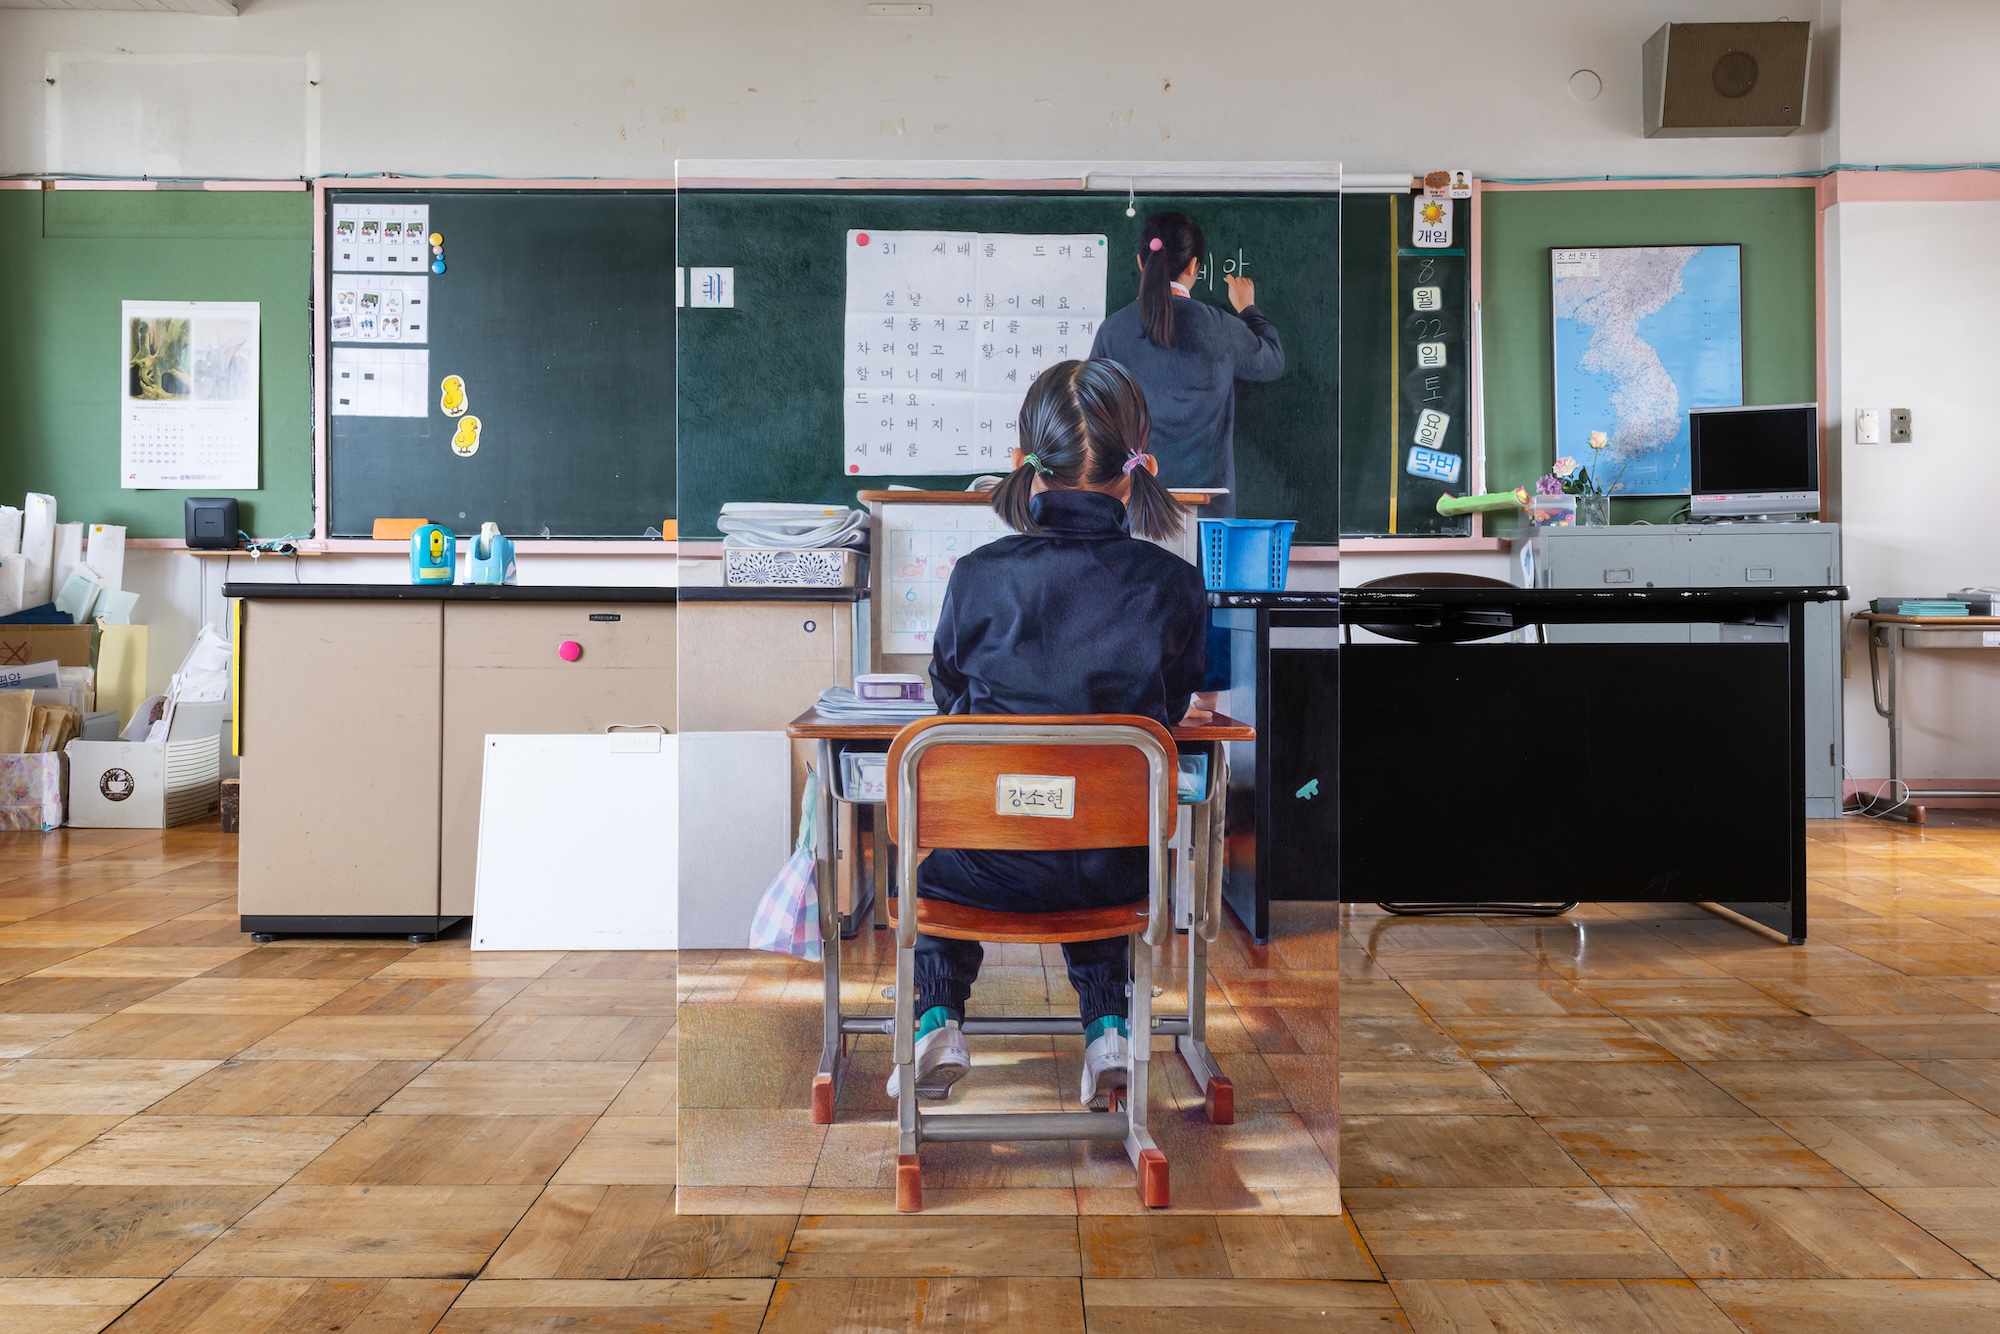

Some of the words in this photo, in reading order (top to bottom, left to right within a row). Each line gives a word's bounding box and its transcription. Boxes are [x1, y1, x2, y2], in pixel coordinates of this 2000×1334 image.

[1417, 230, 1447, 243] 개임
[882, 243, 897, 255] 31
[932, 242, 996, 257] 세배를
[1032, 244, 1096, 259] 드려요
[1556, 252, 1598, 260] 조선전도
[883, 290, 922, 307] 설날
[957, 293, 1086, 310] 아침이예요.
[1416, 289, 1433, 309] 월
[882, 316, 1021, 334] 색동저고리를
[1057, 321, 1093, 336] 곱게
[1414, 318, 1447, 340] 22
[856, 341, 944, 356] 차려입고
[982, 343, 1069, 358] 할아버지
[1421, 346, 1438, 365] 일
[856, 367, 967, 383] 할머니에게
[1422, 375, 1444, 402] 토
[855, 392, 935, 407] 드려요.
[880, 417, 959, 433] 아버지,
[1419, 413, 1441, 446] 요일
[853, 443, 919, 458] 세배를
[1415, 450, 1456, 478] 당번
[946, 536, 957, 551] 2
[906, 587, 917, 601] 6
[1008, 787, 1064, 810] 강소현
